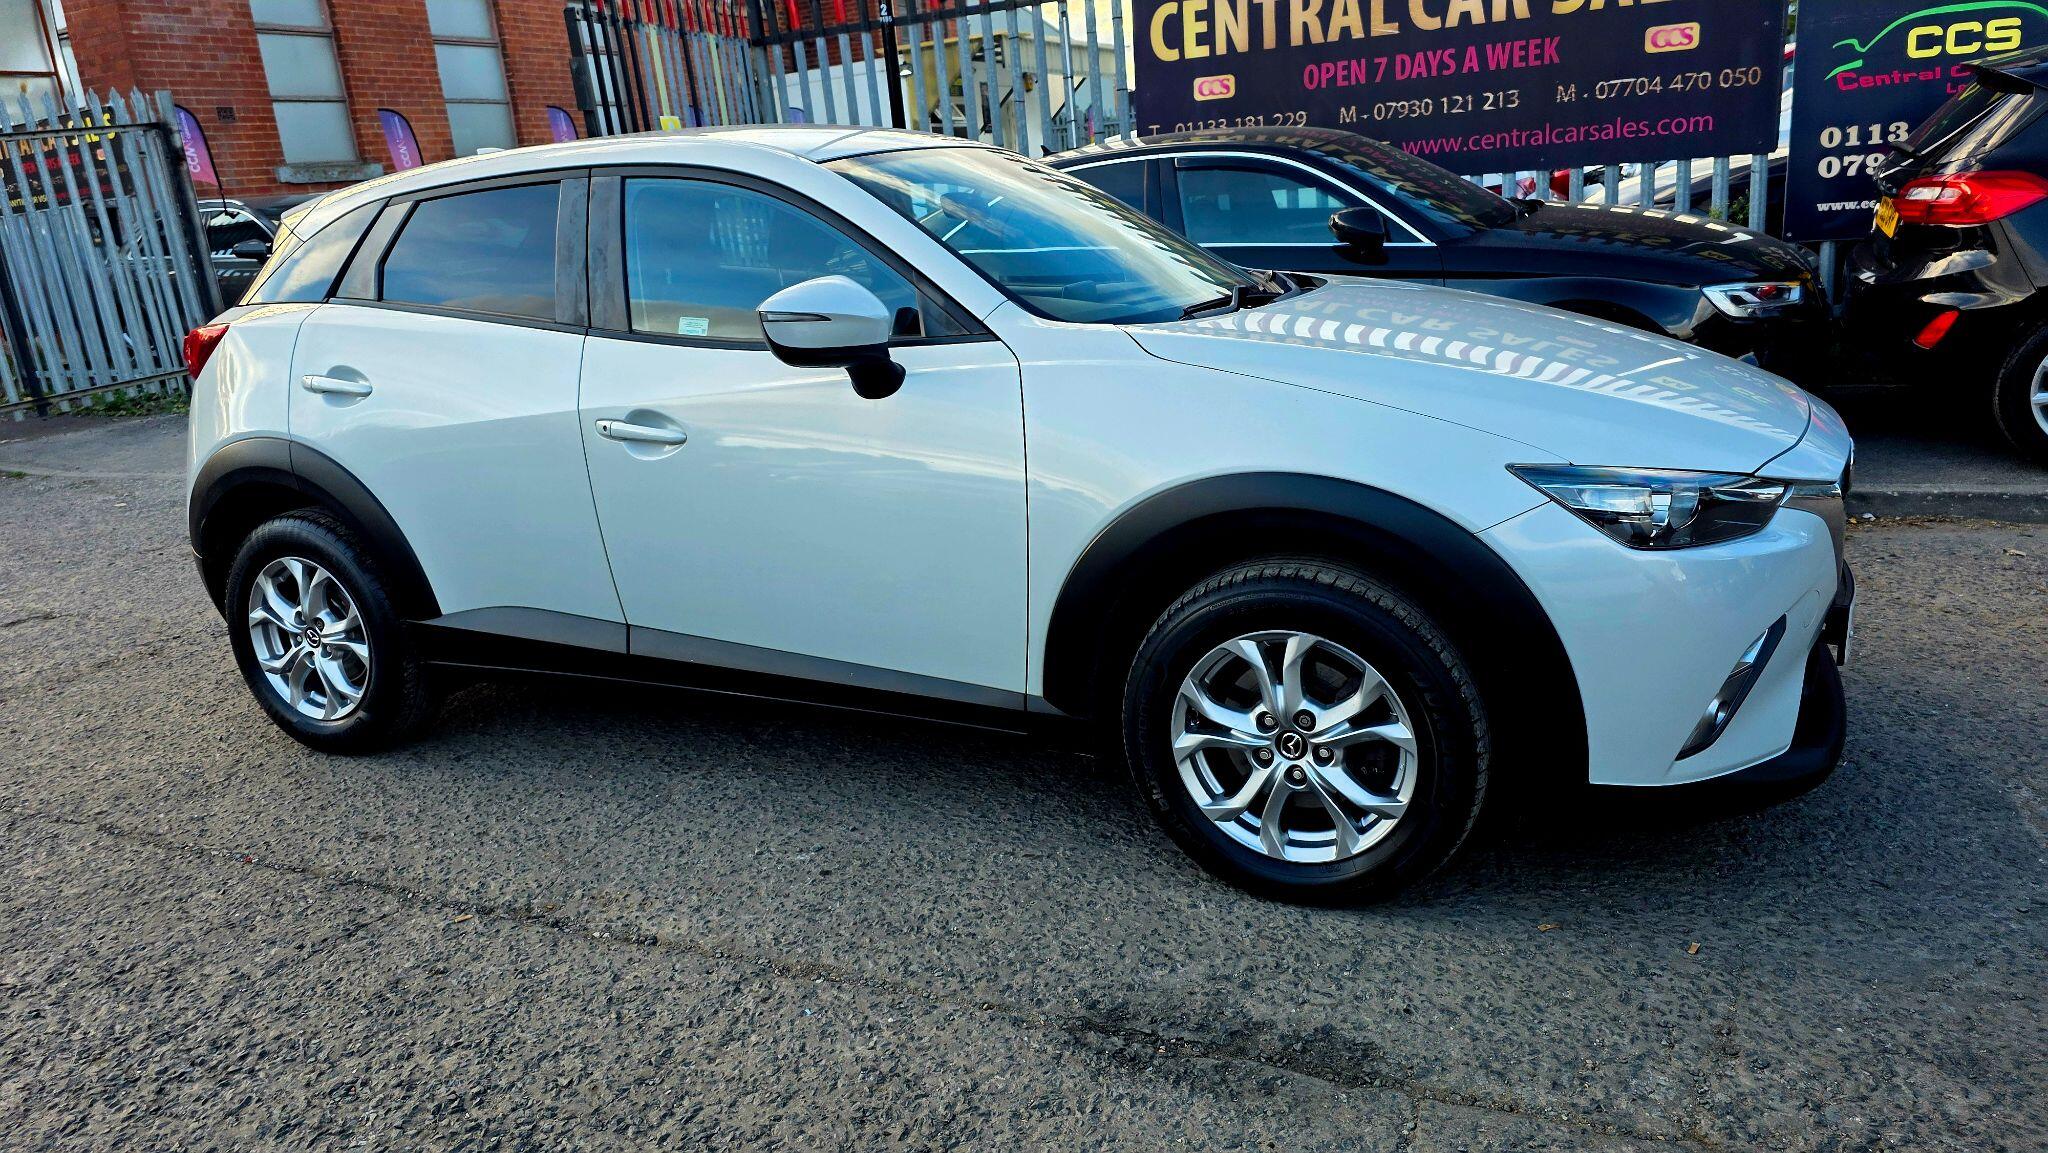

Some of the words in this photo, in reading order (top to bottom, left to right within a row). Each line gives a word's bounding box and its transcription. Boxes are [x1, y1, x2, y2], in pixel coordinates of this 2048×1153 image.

[1150, 0, 1400, 62] CENTRAL
[1907, 17, 2021, 59] CCS
[1303, 60, 1366, 90] OPEN
[1374, 58, 1387, 82] 7
[1395, 49, 1455, 80] DAYS
[1462, 46, 1479, 73] A
[1486, 36, 1561, 71] WEEK
[1836, 67, 1942, 91] Central
[1174, 118, 1227, 134] 01133
[1272, 110, 1308, 128] 229
[1339, 106, 1357, 124] M
[1373, 97, 1433, 121] 07930
[1440, 94, 1473, 114] 121
[1482, 89, 1520, 111] 213
[1556, 83, 1576, 103] M
[1595, 76, 1663, 100] 07704
[1668, 71, 1712, 92] 470
[1718, 66, 1762, 89] 050
[1402, 114, 1714, 155] www.centralcarsales.com
[1819, 121, 1909, 149] 0113
